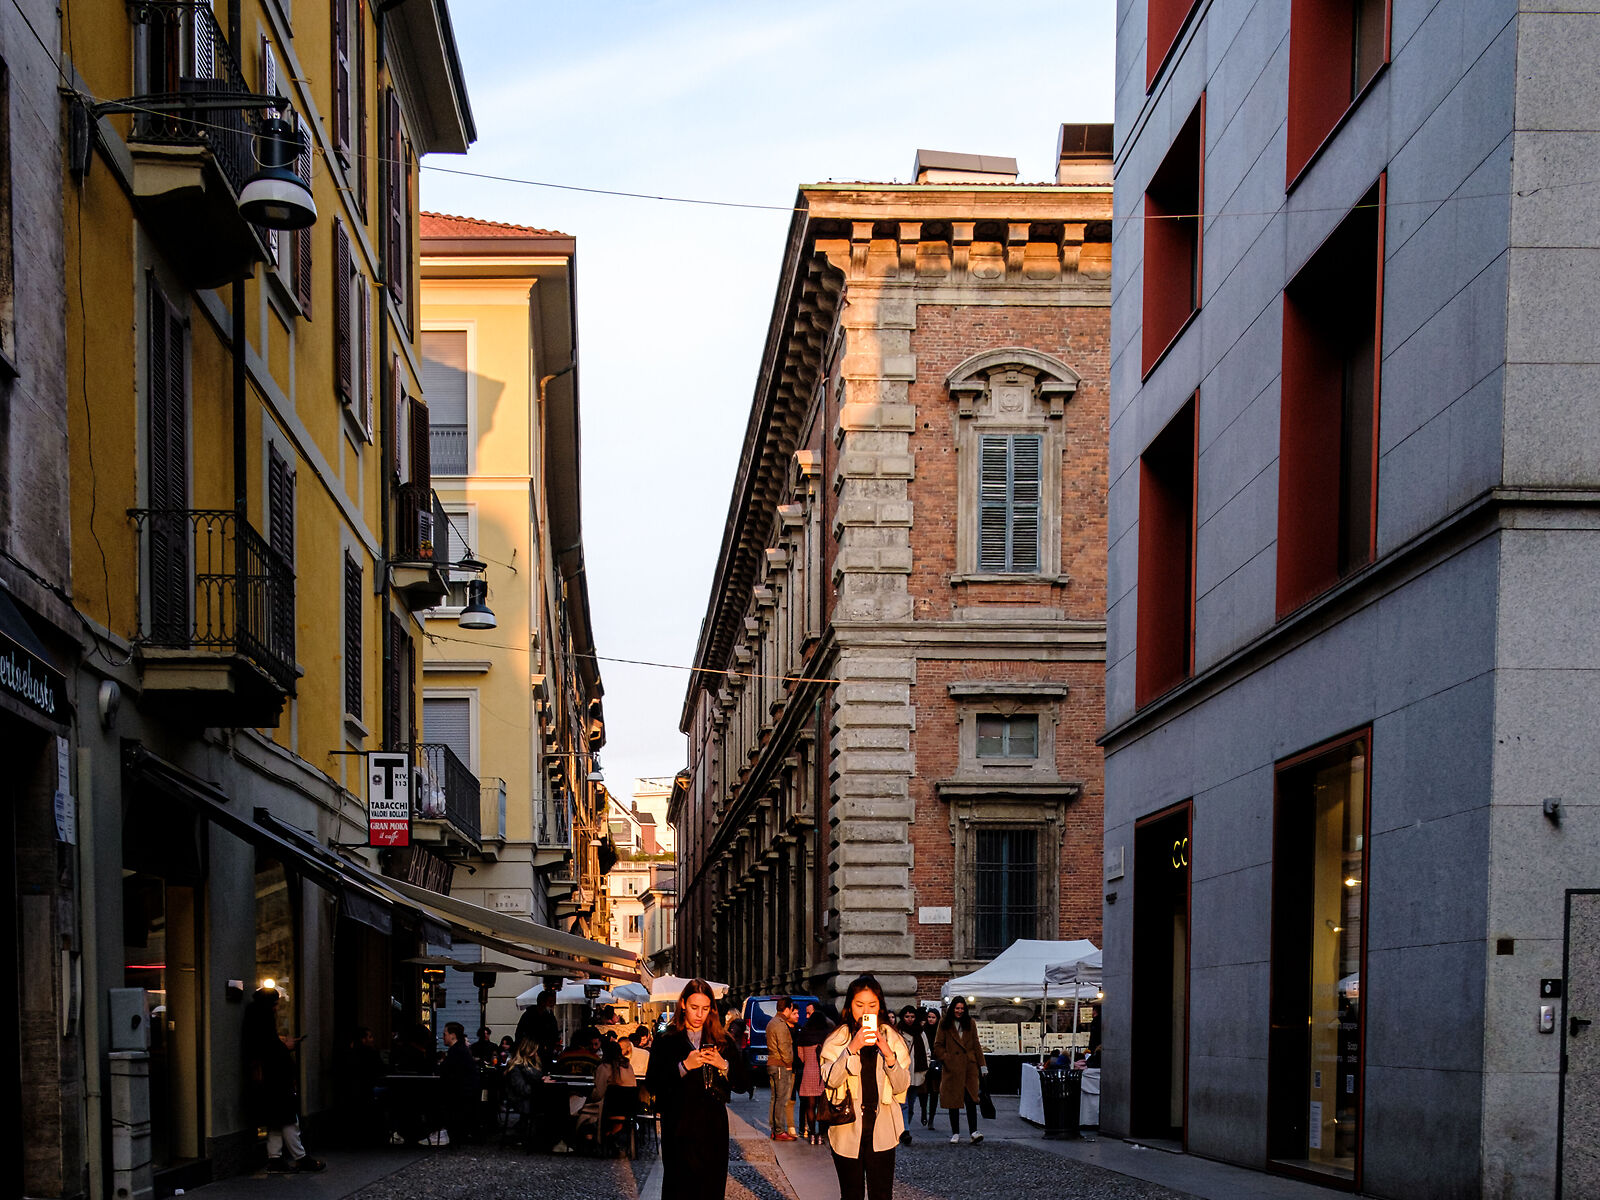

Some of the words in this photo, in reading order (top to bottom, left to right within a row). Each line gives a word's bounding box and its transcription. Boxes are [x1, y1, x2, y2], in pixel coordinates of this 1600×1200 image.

[374, 758, 404, 799] T
[370, 822, 388, 830] GRAN
[389, 822, 408, 830] MOKA
[408, 844, 429, 887] BAR
